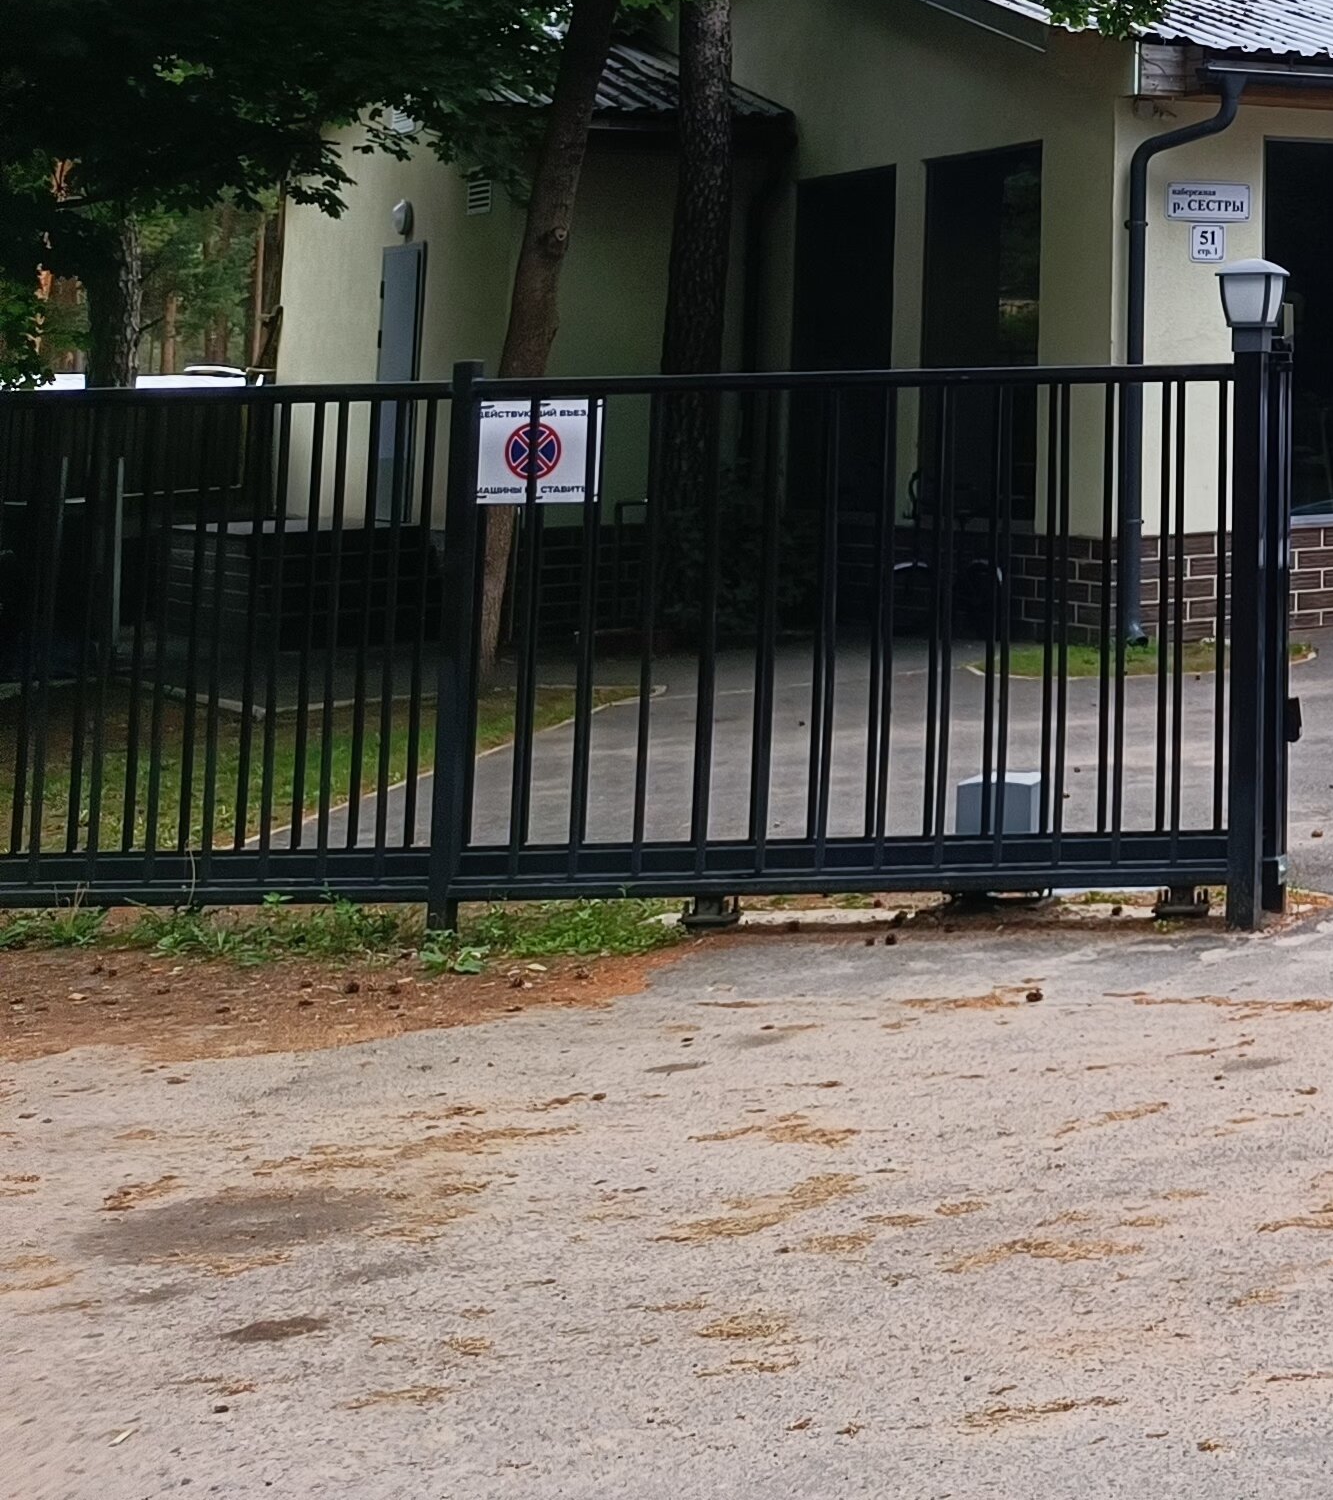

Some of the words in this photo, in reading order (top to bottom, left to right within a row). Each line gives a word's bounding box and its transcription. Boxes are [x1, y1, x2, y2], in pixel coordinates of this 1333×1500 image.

[1173, 201, 1184, 214] р.
[1187, 199, 1244, 213] СЕСТРЫ
[1199, 230, 1216, 246] 51
[1197, 248, 1212, 257] стр.
[559, 409, 588, 418] ВЪЕЗ
